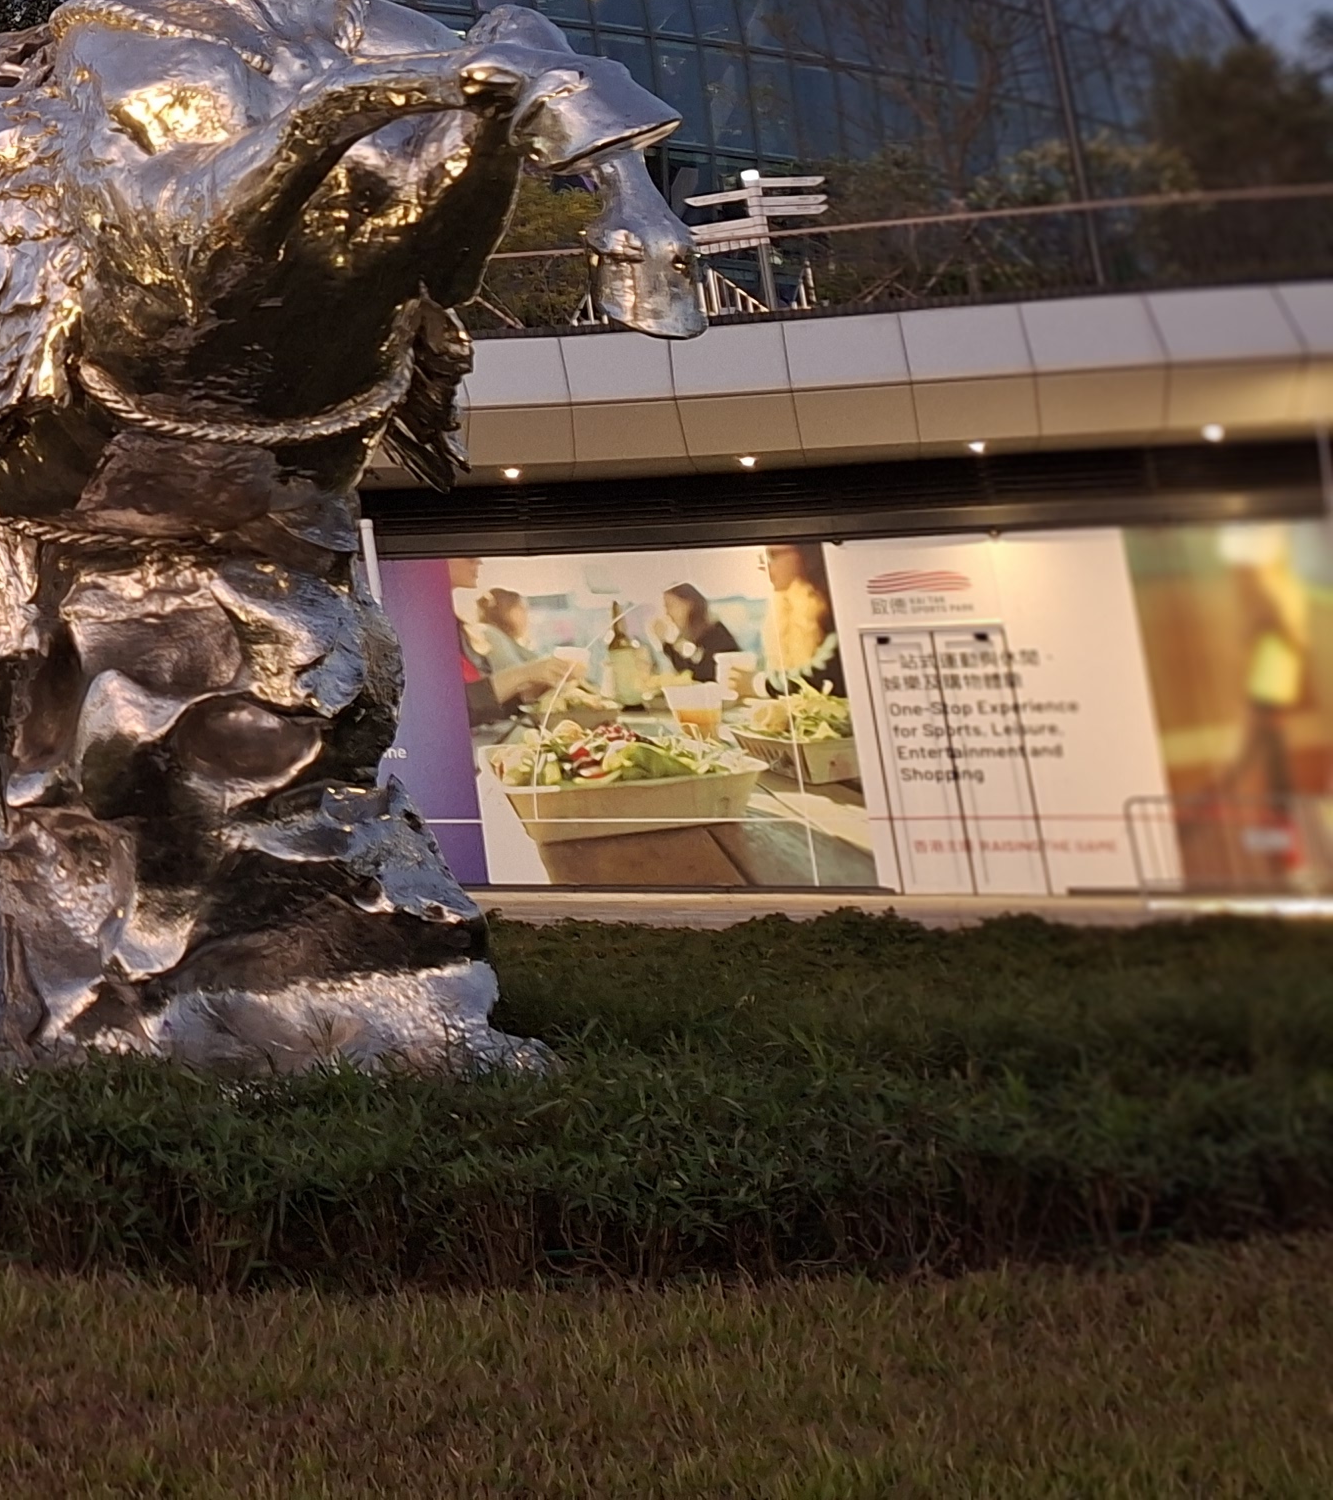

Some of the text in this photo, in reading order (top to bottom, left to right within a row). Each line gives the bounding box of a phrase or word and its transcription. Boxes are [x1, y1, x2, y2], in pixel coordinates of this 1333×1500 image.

[890, 700, 1079, 717] One-Stop Experience
[893, 724, 917, 738] for
[897, 744, 1064, 761] Entertainment and
[901, 767, 985, 784] Shopping
